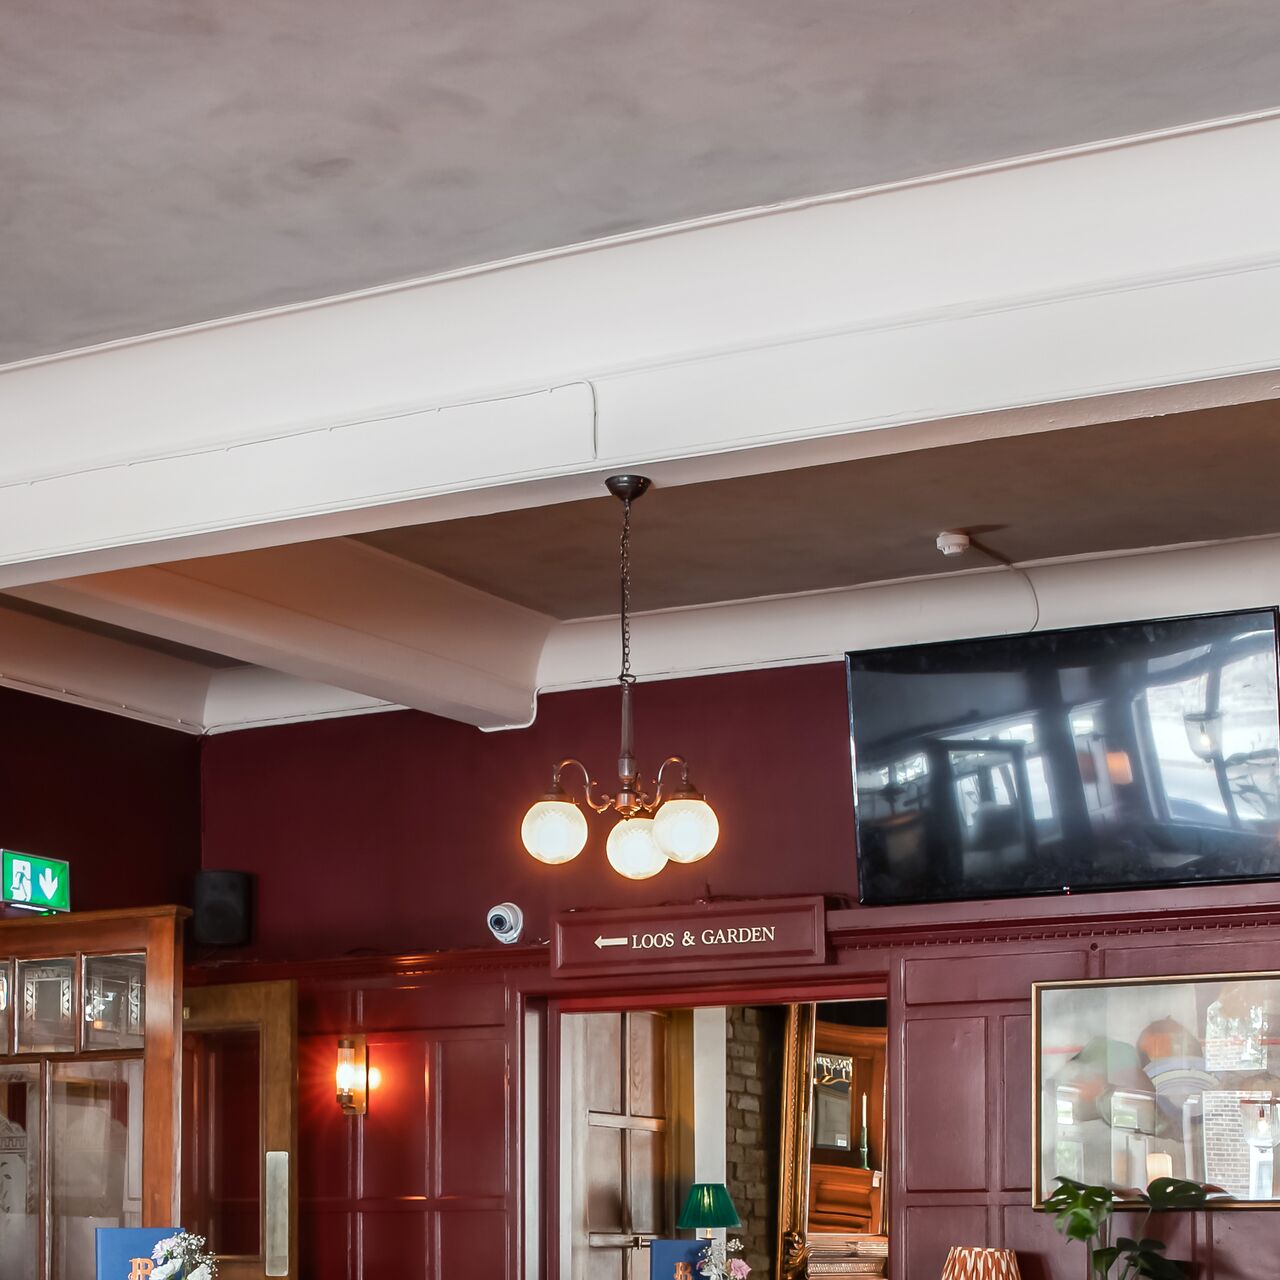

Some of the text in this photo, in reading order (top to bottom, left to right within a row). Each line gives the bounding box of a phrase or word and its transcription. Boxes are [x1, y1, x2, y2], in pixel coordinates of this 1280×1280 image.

[631, 926, 776, 949] LOOS & GARDEN
